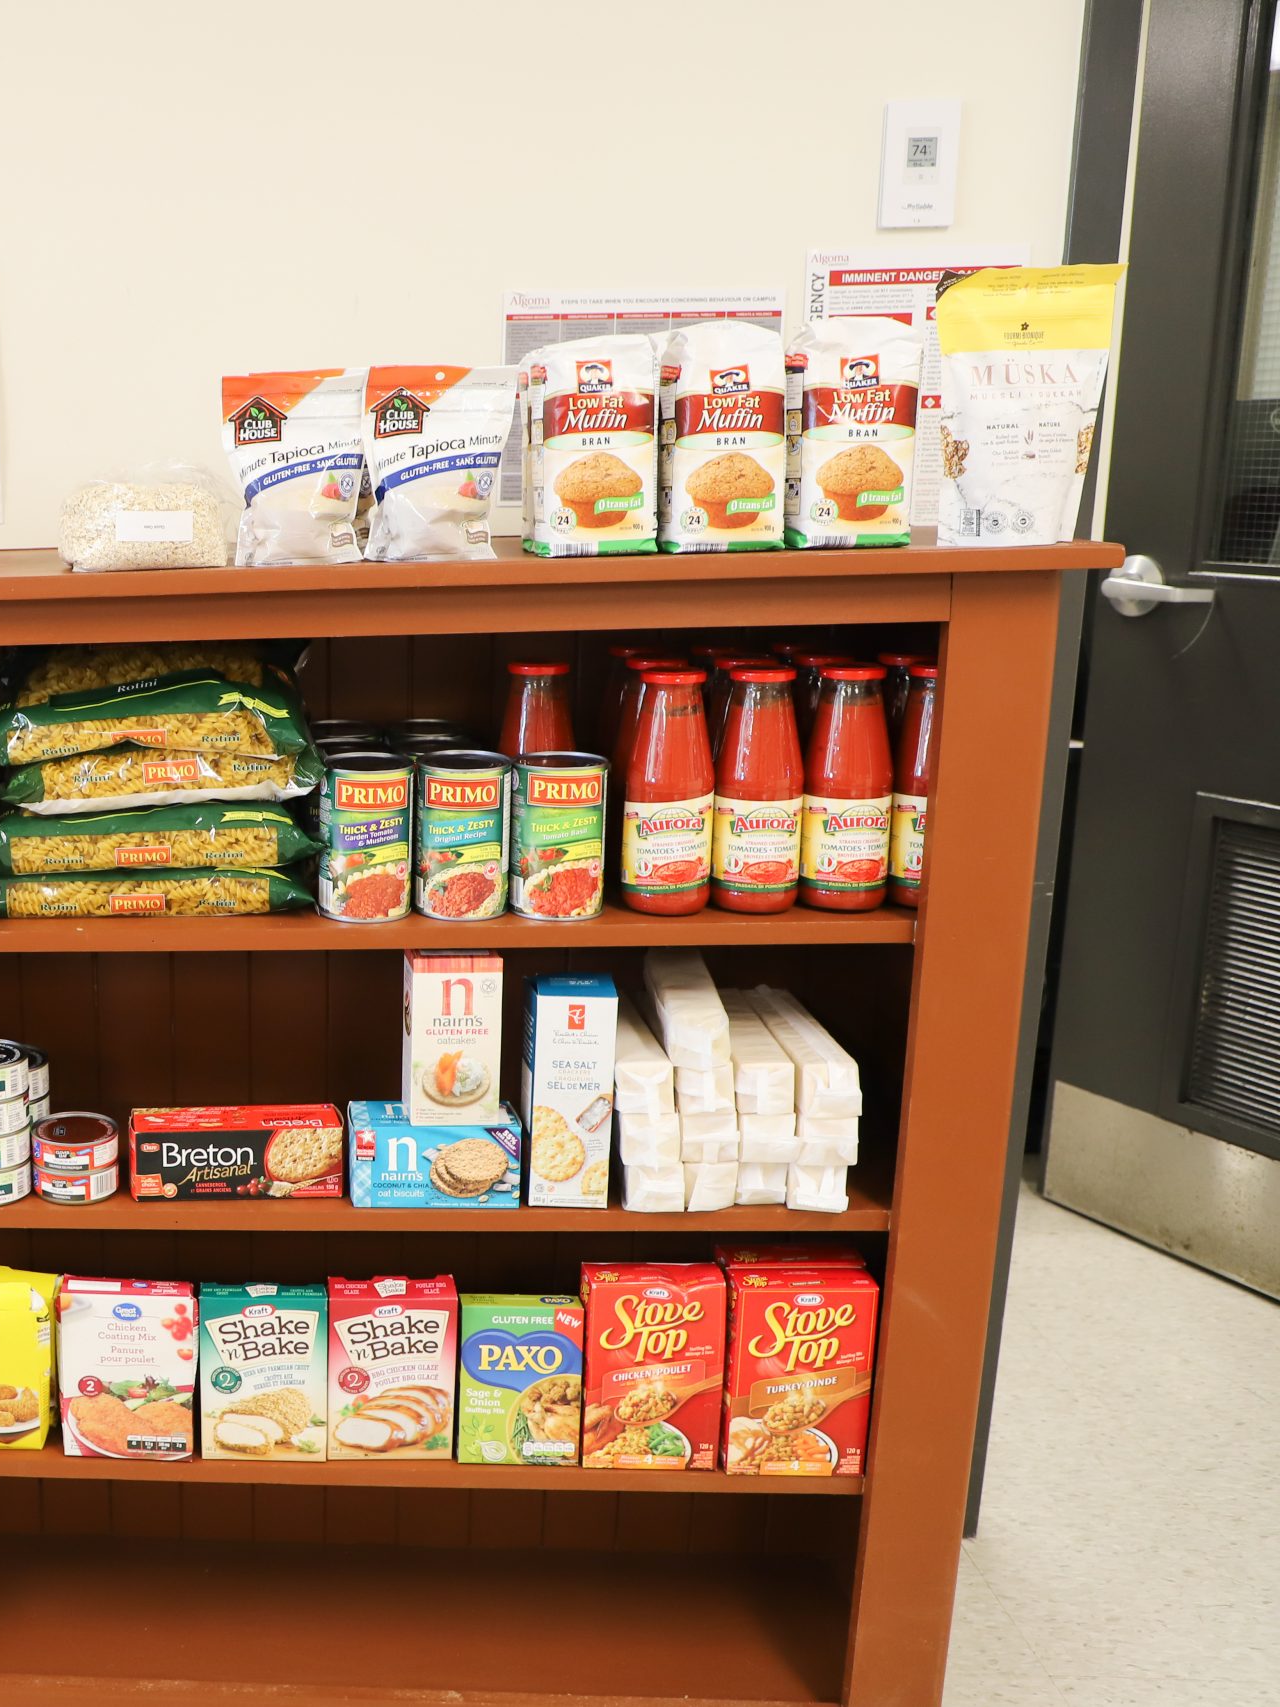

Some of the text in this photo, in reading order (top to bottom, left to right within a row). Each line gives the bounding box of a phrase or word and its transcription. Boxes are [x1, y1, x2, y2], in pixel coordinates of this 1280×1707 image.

[912, 144, 927, 157] 74
[841, 272, 898, 284] IMMINENT
[579, 383, 612, 394] QUAKER
[568, 394, 625, 411] Low Fat
[243, 418, 273, 431] CLUB
[561, 408, 628, 433] Muffin
[986, 421, 1061, 431] NATURAL NATURE
[239, 426, 278, 442] HOUSE
[580, 436, 611, 446] BRAN
[715, 436, 747, 446] BRAN
[597, 497, 642, 510] 0 trans fat
[556, 514, 571, 526] 24
[687, 514, 701, 526] 24
[117, 678, 159, 694] Rotini
[340, 783, 405, 805] PRIMO
[339, 815, 404, 837] THICK & ZESTY
[639, 815, 706, 838] Aurora
[344, 828, 394, 844] Garden Tomato
[365, 833, 399, 845] Mushroom
[434, 829, 488, 845] Original Recipe
[543, 827, 589, 841] Tomato Basil
[432, 1014, 484, 1028] nairn's
[425, 1027, 490, 1036] GLUTEN FREE
[436, 1036, 478, 1046] oatcakes
[551, 1060, 599, 1070] SEA SALT
[546, 1081, 566, 1091] SEL
[578, 1082, 602, 1092] MER
[161, 1142, 255, 1169] Breton
[176, 1160, 252, 1187] Artisanal
[376, 1188, 425, 1199] oat biscuits
[115, 1306, 138, 1316] Great
[247, 1306, 269, 1318] Kraft
[377, 1306, 399, 1317] Kraft
[491, 1315, 555, 1326] GLUTEN FREE
[555, 1311, 583, 1330] NEW
[599, 1294, 706, 1352] Stove
[106, 1321, 148, 1334] Chicken
[217, 1314, 311, 1346] Shake
[97, 1330, 158, 1343] Coating Mix
[110, 1345, 145, 1356] Panure
[633, 1327, 690, 1364] Top
[477, 1344, 564, 1376] PAXO
[468, 1397, 501, 1408] Onion
[464, 1406, 506, 1416] Stuffing Mix
[645, 1453, 655, 1466] 4
[789, 1458, 801, 1473] 4
